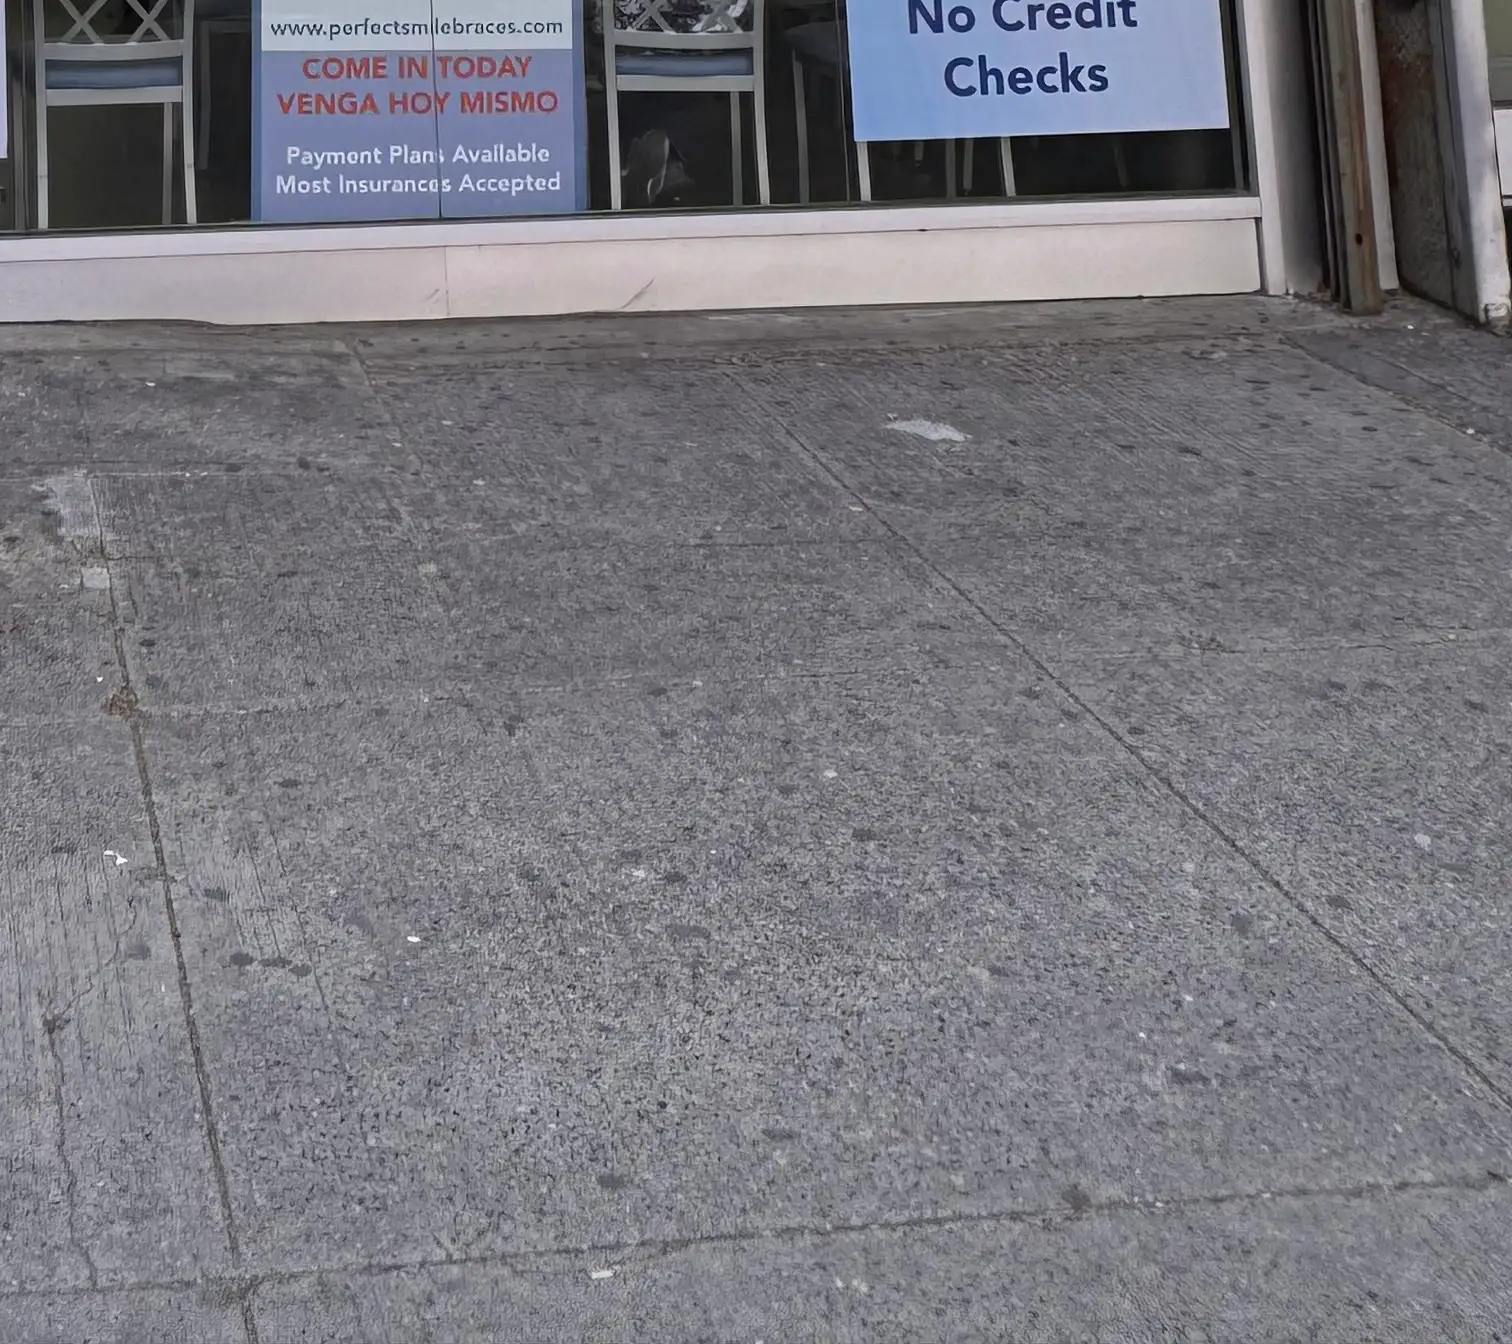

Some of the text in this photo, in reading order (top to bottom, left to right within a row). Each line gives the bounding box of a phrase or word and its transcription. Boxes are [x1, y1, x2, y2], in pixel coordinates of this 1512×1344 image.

[270, 17, 563, 41] www.perfectsmilebraces.com
[302, 55, 533, 80] COME IN TODAY
[944, 51, 1110, 97] Checks
[276, 91, 559, 115] VENGA HOY MISMO
[287, 146, 382, 170] Payment
[451, 142, 550, 164] Available
[276, 170, 561, 196] Most Insurances Accepted
